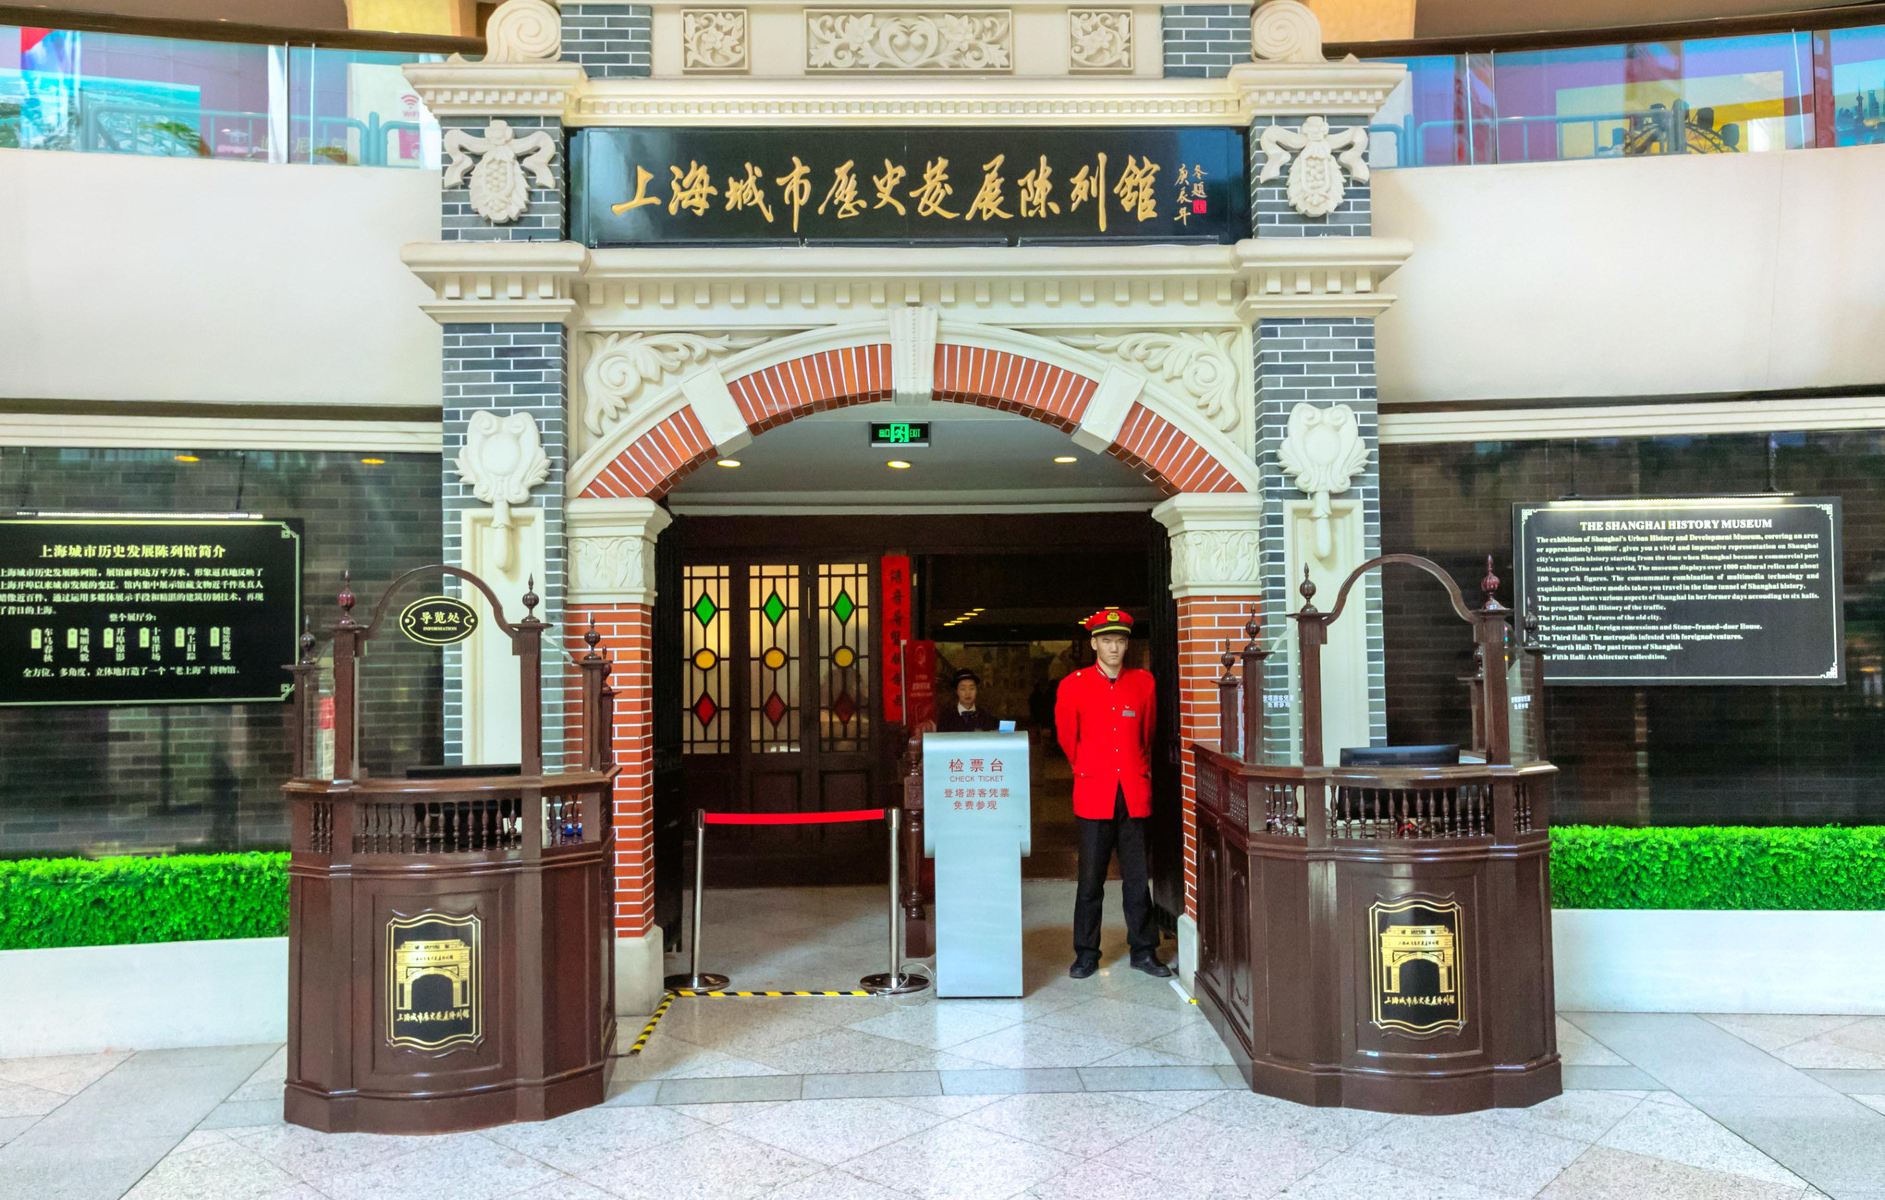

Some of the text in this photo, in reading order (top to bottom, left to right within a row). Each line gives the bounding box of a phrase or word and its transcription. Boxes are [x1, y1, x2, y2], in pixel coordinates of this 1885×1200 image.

[910, 429, 921, 438] EXIT
[1580, 519, 1772, 531] THE SHANGHAI HISTORY MUSEUM
[1591, 535, 1627, 544] Shanghai's
[1650, 534, 1674, 543] History
[1689, 534, 1732, 542] Development
[1733, 533, 1763, 542] Museum,
[1764, 533, 1793, 541] covering
[39, 544, 226, 559] 上海城市历史发展陈列馆简介
[1545, 545, 1591, 554] approximately
[1622, 544, 1639, 553] gives
[1692, 543, 1727, 552] impressive
[1728, 543, 1776, 551] representation
[1787, 542, 1819, 551] Shanghai
[1536, 555, 1554, 564] city's
[1586, 555, 1609, 563] history
[1610, 554, 1636, 563] starting
[1701, 553, 1732, 562] Shanghai
[1804, 552, 1819, 561] port
[1537, 565, 1560, 574] linking
[1680, 564, 1706, 572] displays
[1584, 574, 1608, 583] figures.
[1768, 572, 1804, 581] technology
[1537, 585, 1566, 593] exquisite
[1748, 583, 1779, 591] Shanghai
[1780, 582, 1806, 591] history.
[1624, 594, 1648, 602] aspects
[1657, 593, 1686, 602] Shanghai
[1732, 593, 1747, 601] days
[1551, 604, 1580, 613] prologue
[1598, 604, 1622, 612] History
[419, 611, 461, 625] 导览处
[1646, 613, 1662, 622] city.
[1595, 624, 1621, 632] Foreign
[1603, 634, 1638, 642] metropolis
[1607, 643, 1621, 652] past
[1650, 643, 1683, 652] Shanghai.
[948, 758, 1004, 773] 检票台
[949, 775, 975, 783] CHECK
[944, 788, 1010, 799] 登塔游客凭票
[953, 800, 998, 810] 免费参观
